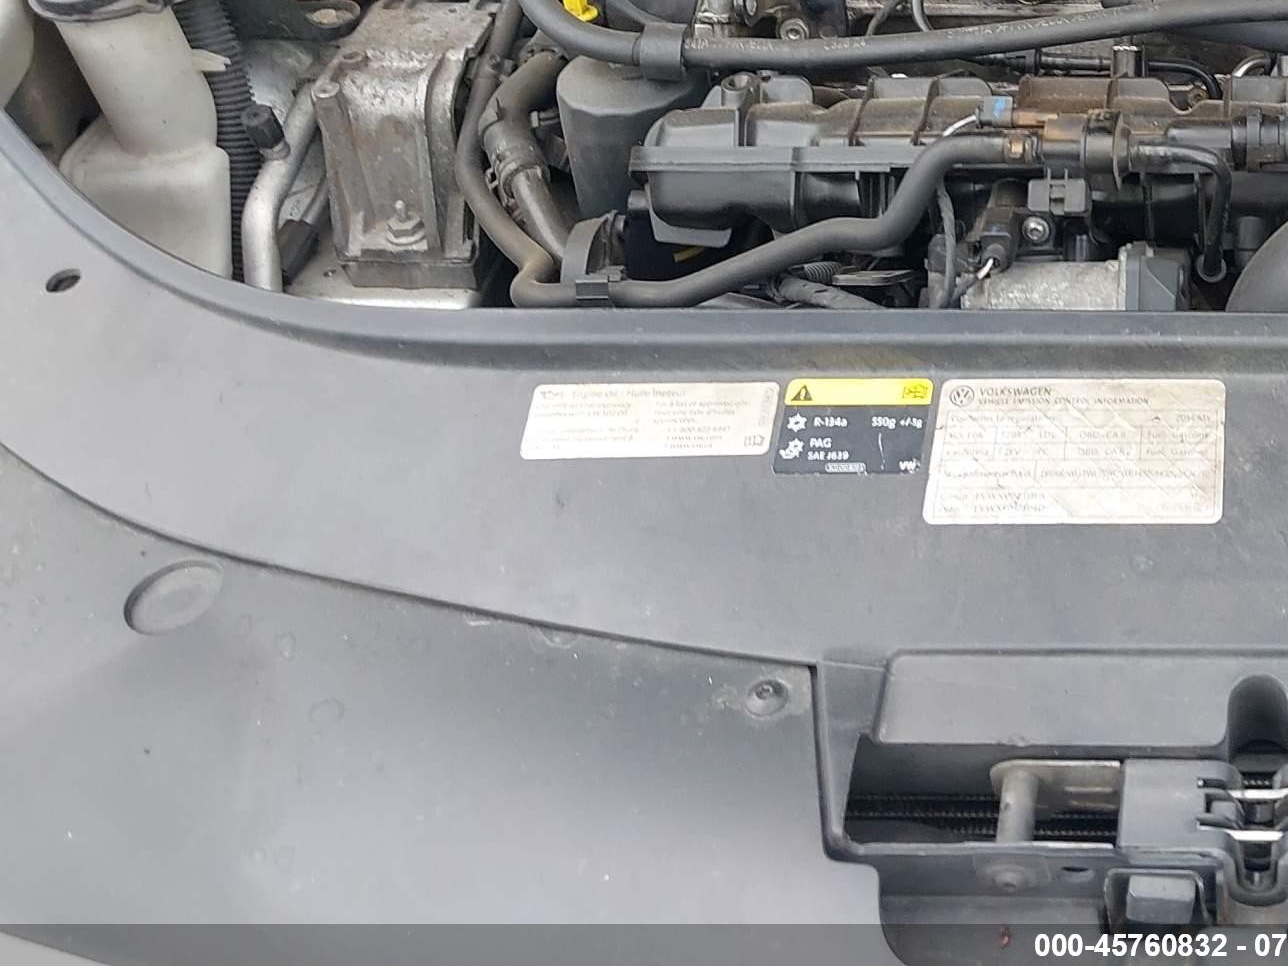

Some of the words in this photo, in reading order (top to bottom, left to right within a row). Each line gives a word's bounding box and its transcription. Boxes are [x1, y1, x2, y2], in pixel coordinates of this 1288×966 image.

[980, 387, 1052, 397] VOLKSWAGEN
[809, 437, 832, 449] PAG
[806, 450, 825, 461] SAE
